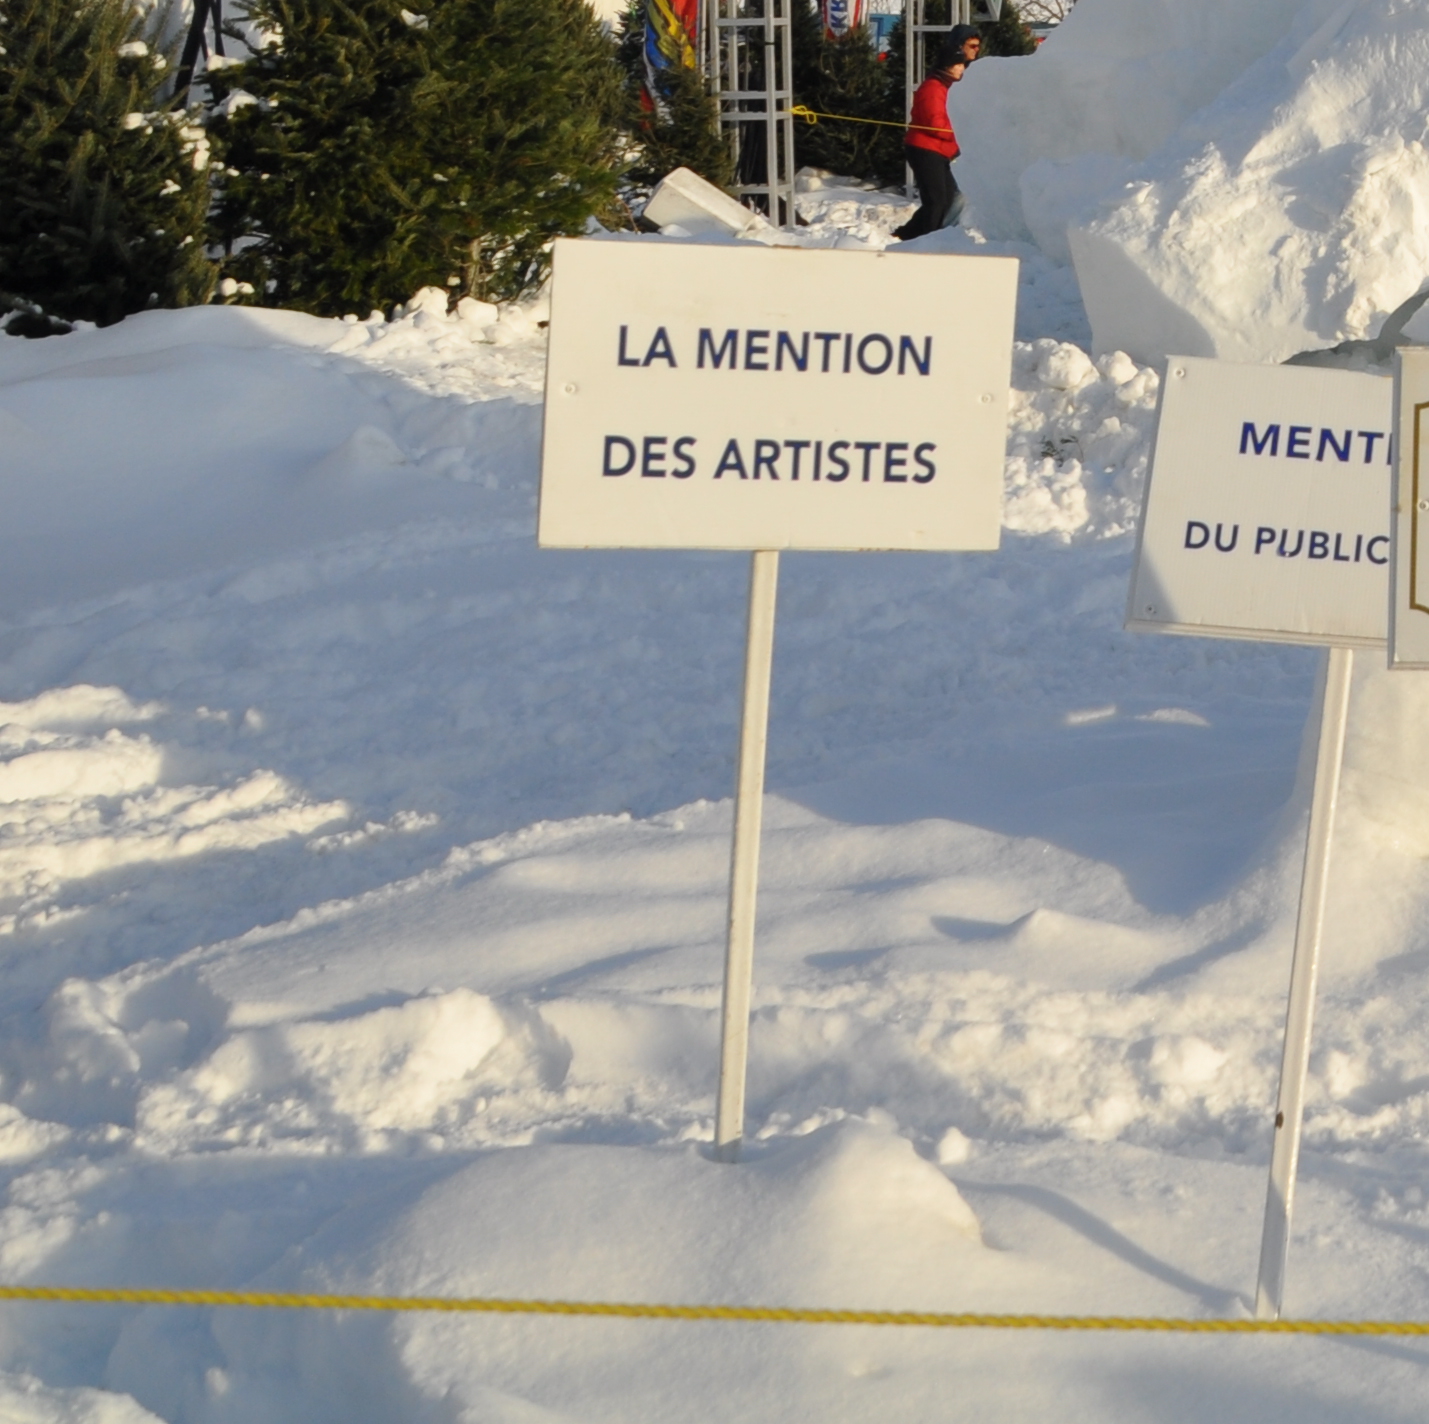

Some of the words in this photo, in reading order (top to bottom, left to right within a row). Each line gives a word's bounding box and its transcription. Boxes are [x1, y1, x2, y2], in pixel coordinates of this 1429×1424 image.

[617, 326, 678, 368] LA
[696, 327, 933, 376] MENTION
[602, 435, 697, 480] DES
[713, 438, 937, 484] ARTISTES
[1184, 520, 1239, 553] DU
[1254, 526, 1390, 565] PUBLIC
